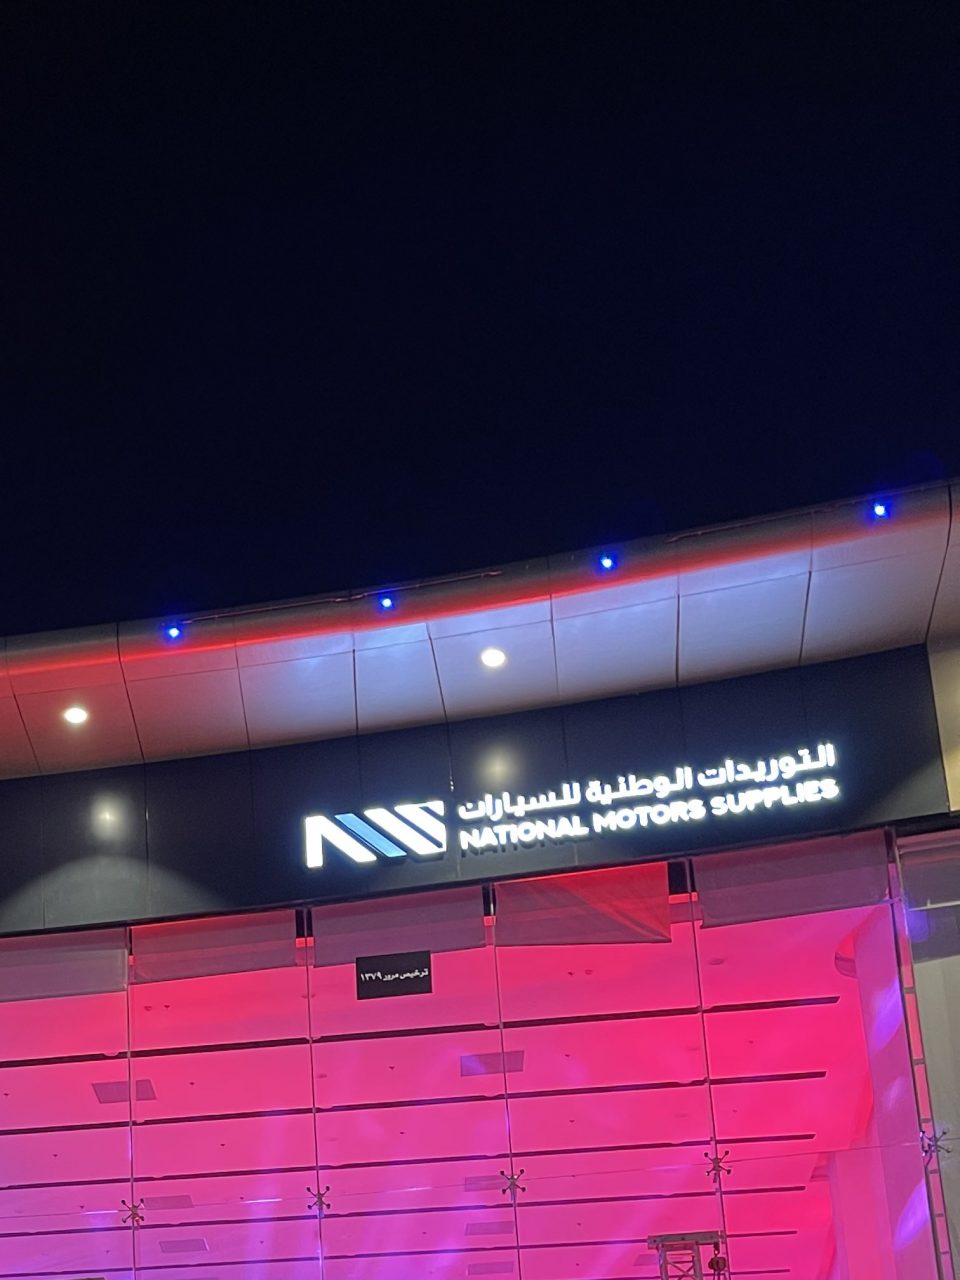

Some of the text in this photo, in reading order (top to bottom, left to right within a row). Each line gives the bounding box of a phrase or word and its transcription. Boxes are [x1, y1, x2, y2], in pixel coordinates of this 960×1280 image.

[458, 743, 836, 821] التوريدات الوطنية للسيارات
[460, 778, 840, 849] NATIONAL MOTORS SUPPLIES
